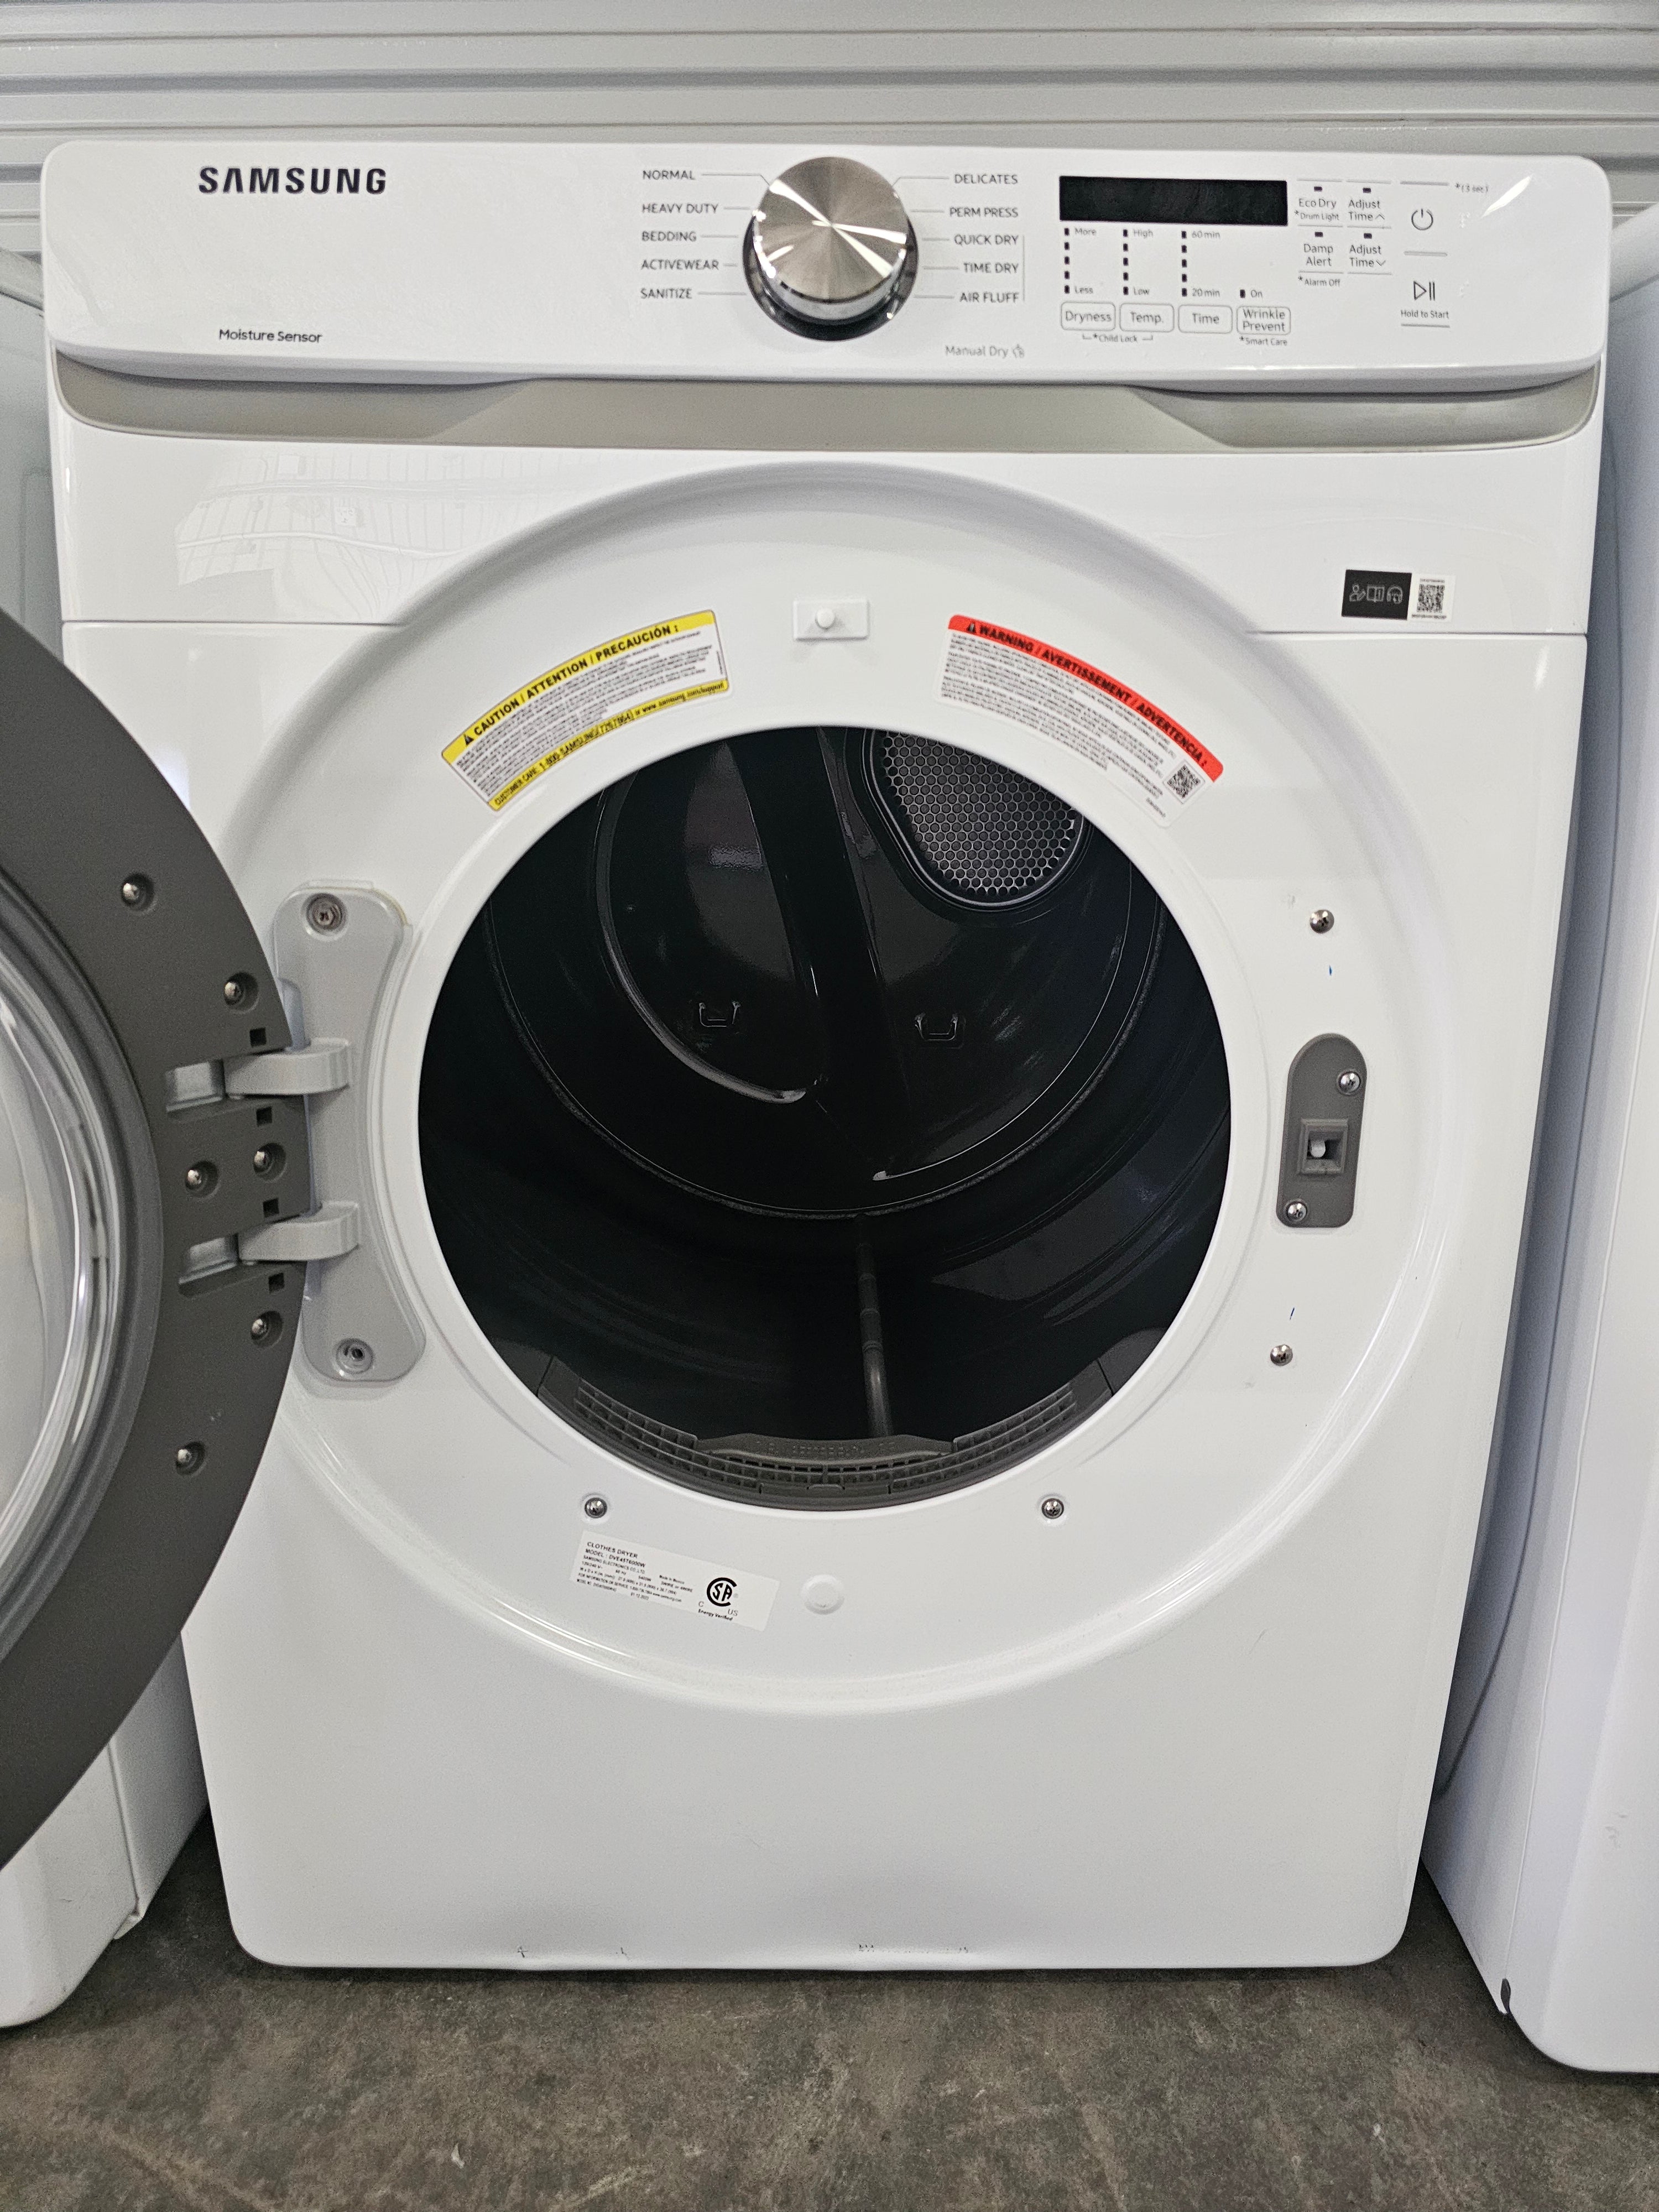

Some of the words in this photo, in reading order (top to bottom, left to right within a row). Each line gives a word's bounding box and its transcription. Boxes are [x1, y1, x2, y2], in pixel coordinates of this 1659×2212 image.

[199, 166, 387, 195] SAMSUNG
[643, 170, 696, 180] NORMAL
[954, 174, 1018, 184] DELICATES
[642, 203, 682, 213] HEAVY
[686, 203, 719, 214] DUTY
[1299, 198, 1317, 208] Eco
[1319, 199, 1337, 210] Dry
[1348, 199, 1380, 210] Adjust
[950, 207, 980, 217] PERM
[984, 207, 1019, 218] PRESS
[1322, 213, 1339, 222] Light
[1348, 212, 1374, 221] Time
[641, 231, 697, 242] BEDDING
[1074, 228, 1097, 236] More
[1133, 229, 1153, 238] High
[954, 234, 992, 247] QUICK
[995, 234, 1019, 246] DRY
[1303, 244, 1334, 254] Damp
[1349, 245, 1381, 255] Adjust
[641, 259, 719, 270] ACTIVEWEAR
[1306, 257, 1332, 267] Alert
[1349, 258, 1374, 268] Time
[964, 262, 992, 273] TIME
[995, 262, 1019, 274] DRY
[1328, 279, 1340, 288] Off
[640, 288, 692, 299] SANITIZE
[1074, 286, 1093, 294] Less
[1133, 287, 1150, 296] Low
[1250, 289, 1262, 298] On
[959, 291, 979, 302] AIR
[983, 291, 1019, 303] FLUFF
[1065, 311, 1112, 323] Dryness
[1130, 311, 1164, 325] Temp.
[1192, 313, 1219, 324] Time
[1243, 309, 1285, 320] Wrinkle
[1401, 310, 1419, 319] Hold
[1421, 310, 1428, 319] to
[1430, 310, 1449, 320] Start
[1243, 322, 1286, 333] Prevent
[219, 328, 274, 342] Moisture
[278, 331, 323, 343] Sensor
[1120, 335, 1138, 343] Lock
[1270, 338, 1288, 347] Care
[945, 345, 986, 356] Manual
[990, 346, 1009, 359] Dry
[474, 698, 520, 735] CAUTION
[526, 658, 588, 700] ATTENTION
[596, 625, 671, 661] PRECAUCIÓN
[980, 625, 1034, 653] WARNING
[1042, 649, 1132, 702] AVERTISSEMENT
[1137, 703, 1203, 761] ADVERTENCIA
[586, 1548, 604, 1558] MODEL
[587, 1541, 615, 1553] CLOTHES
[617, 1549, 638, 1558] DRYER
[698, 1608, 714, 1618] Energy
[715, 1613, 733, 1621] Verified
